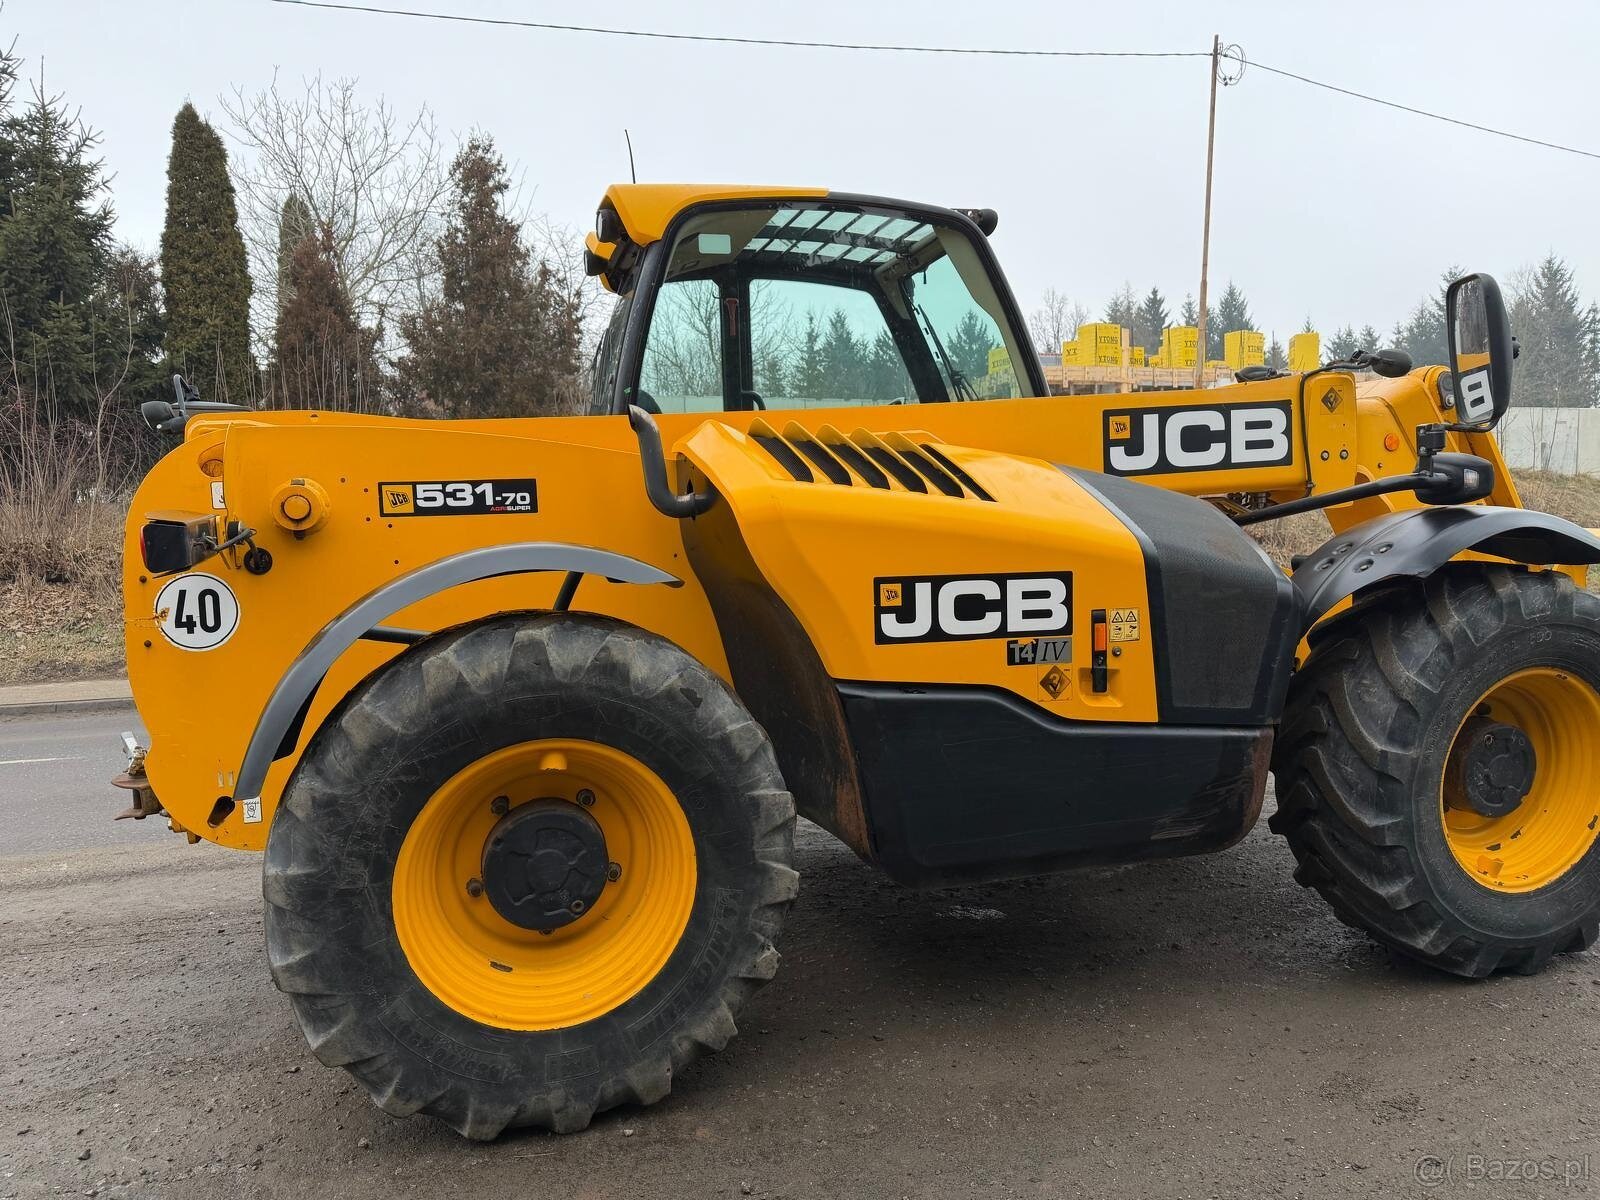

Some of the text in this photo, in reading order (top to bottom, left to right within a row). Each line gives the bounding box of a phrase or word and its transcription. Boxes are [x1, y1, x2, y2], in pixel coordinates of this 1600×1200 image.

[1109, 407, 1289, 471] JCB
[390, 491, 410, 506] JCB
[174, 588, 222, 634] 40
[880, 577, 1069, 638] JCB
